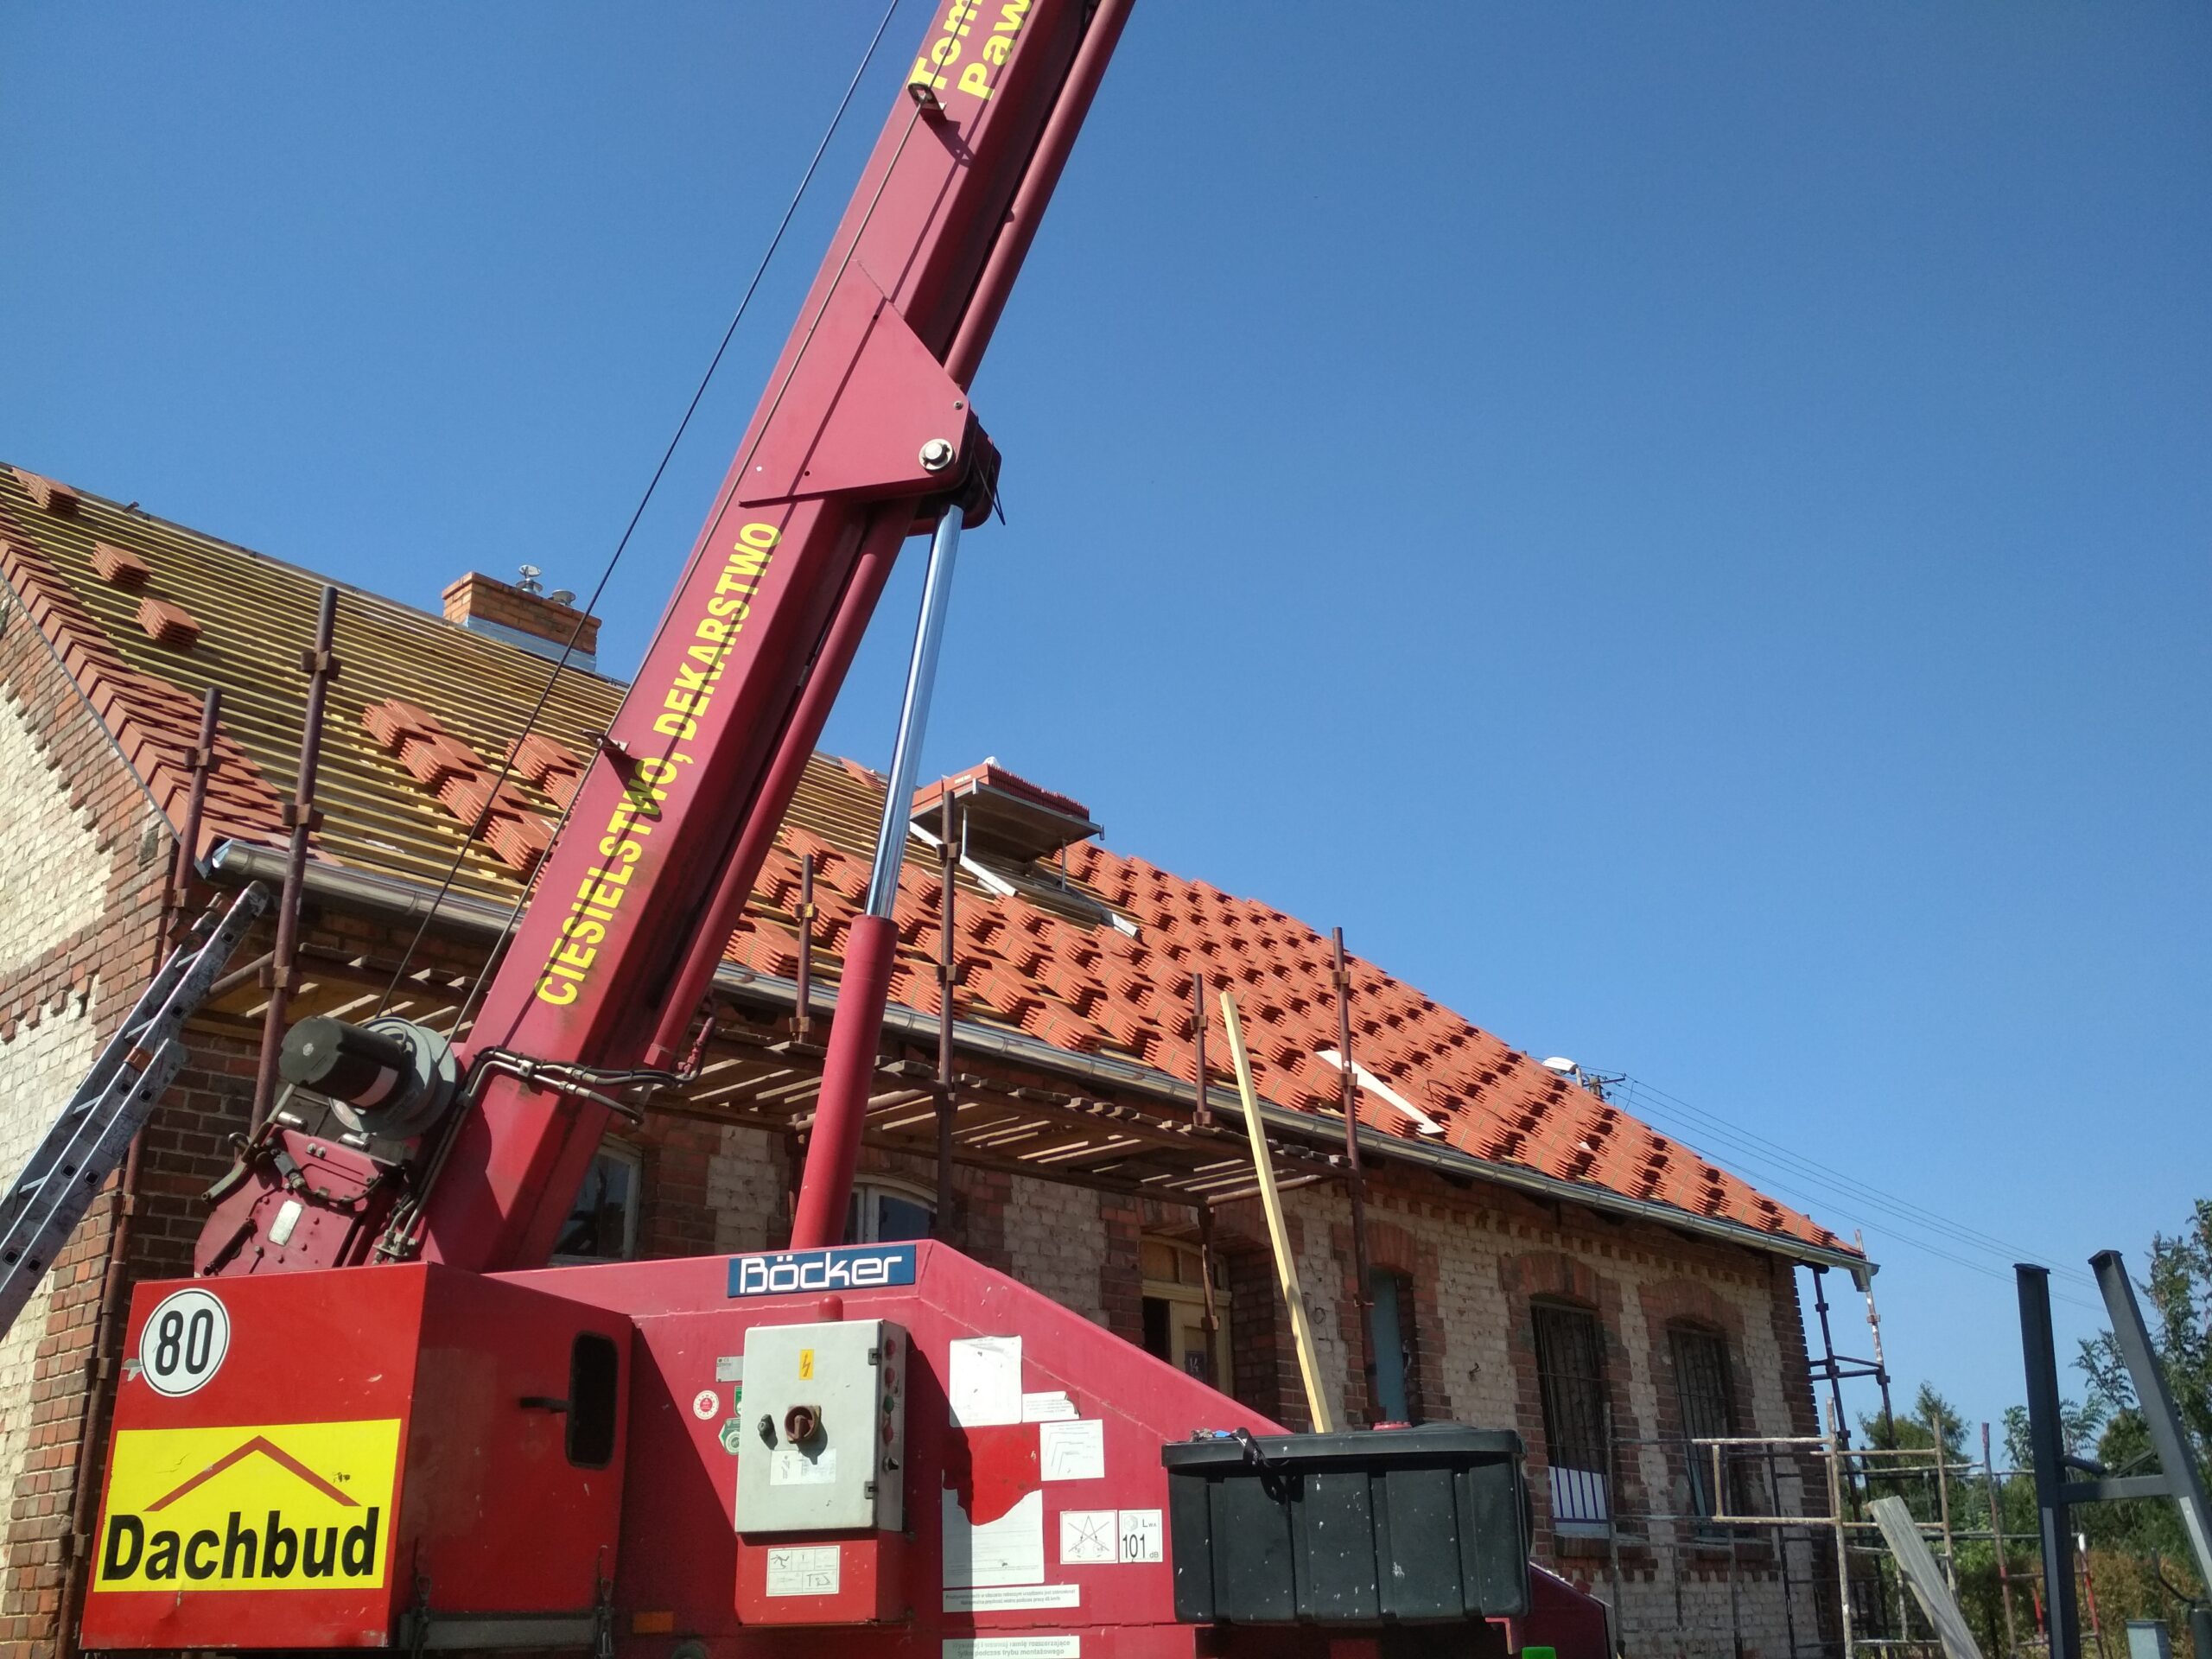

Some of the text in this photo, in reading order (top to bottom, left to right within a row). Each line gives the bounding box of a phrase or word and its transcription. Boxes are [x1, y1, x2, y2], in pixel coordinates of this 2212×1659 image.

[535, 523, 782, 1005] CIESIELSTWO, DEKARSTWO
[740, 1252, 902, 1294] Böcker
[155, 1308, 214, 1376] 80
[101, 1506, 380, 1581] Dachbud
[1122, 1534, 1145, 1559] 101
[1002, 1649, 1019, 1657] trybu
